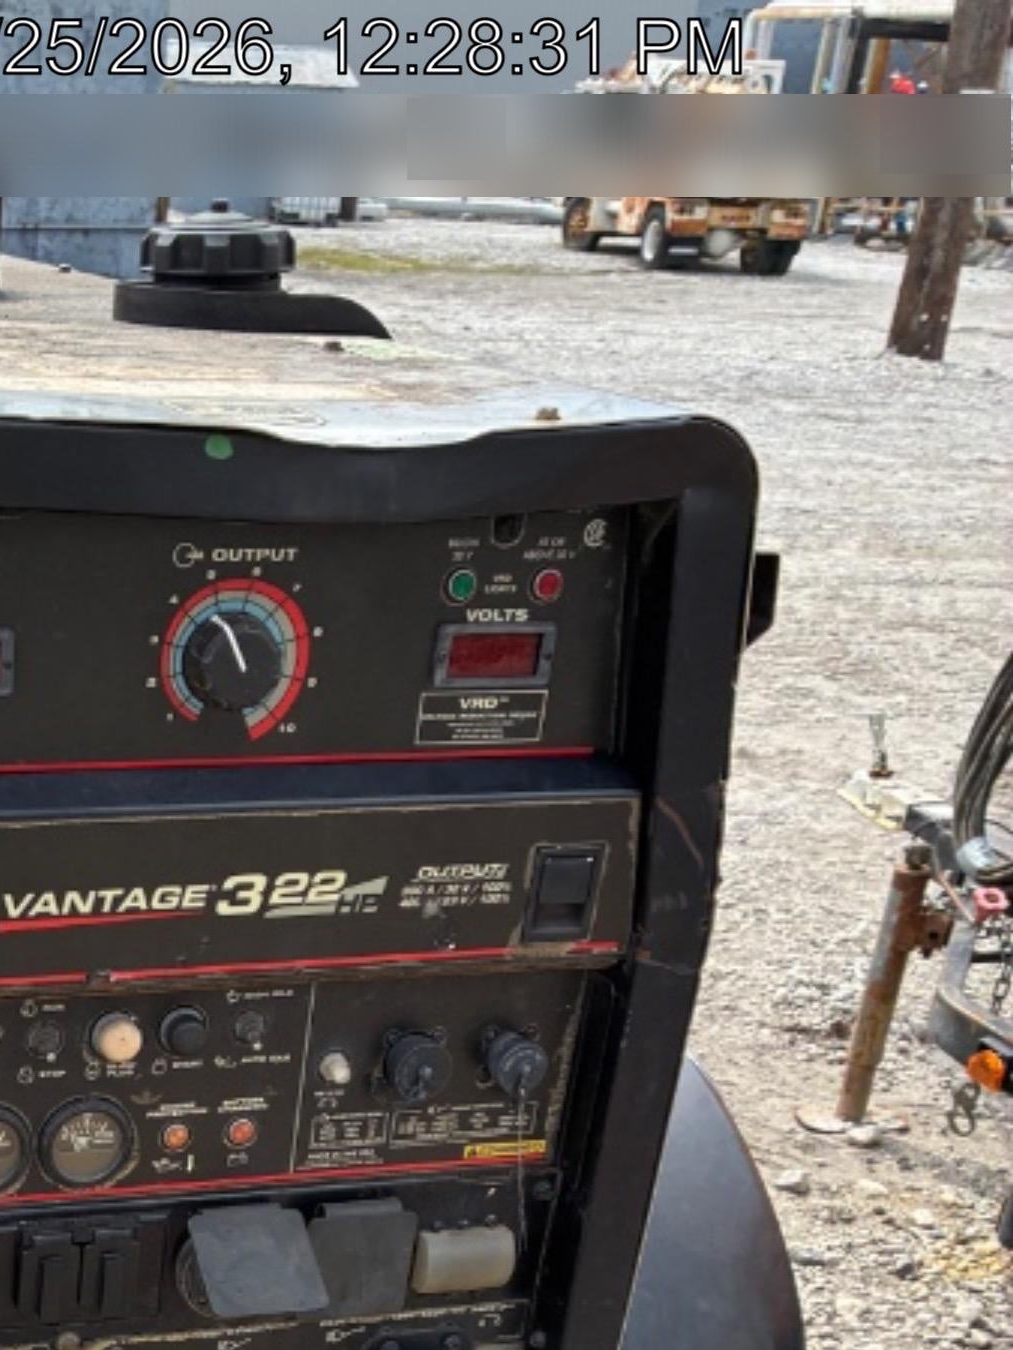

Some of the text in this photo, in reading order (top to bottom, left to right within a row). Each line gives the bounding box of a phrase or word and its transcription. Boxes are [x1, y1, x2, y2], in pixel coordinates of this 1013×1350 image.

[211, 548, 299, 563] OUTPUT
[466, 608, 529, 622] VOLTS
[2, 884, 211, 919] VANTAGE
[215, 869, 349, 917] 322
